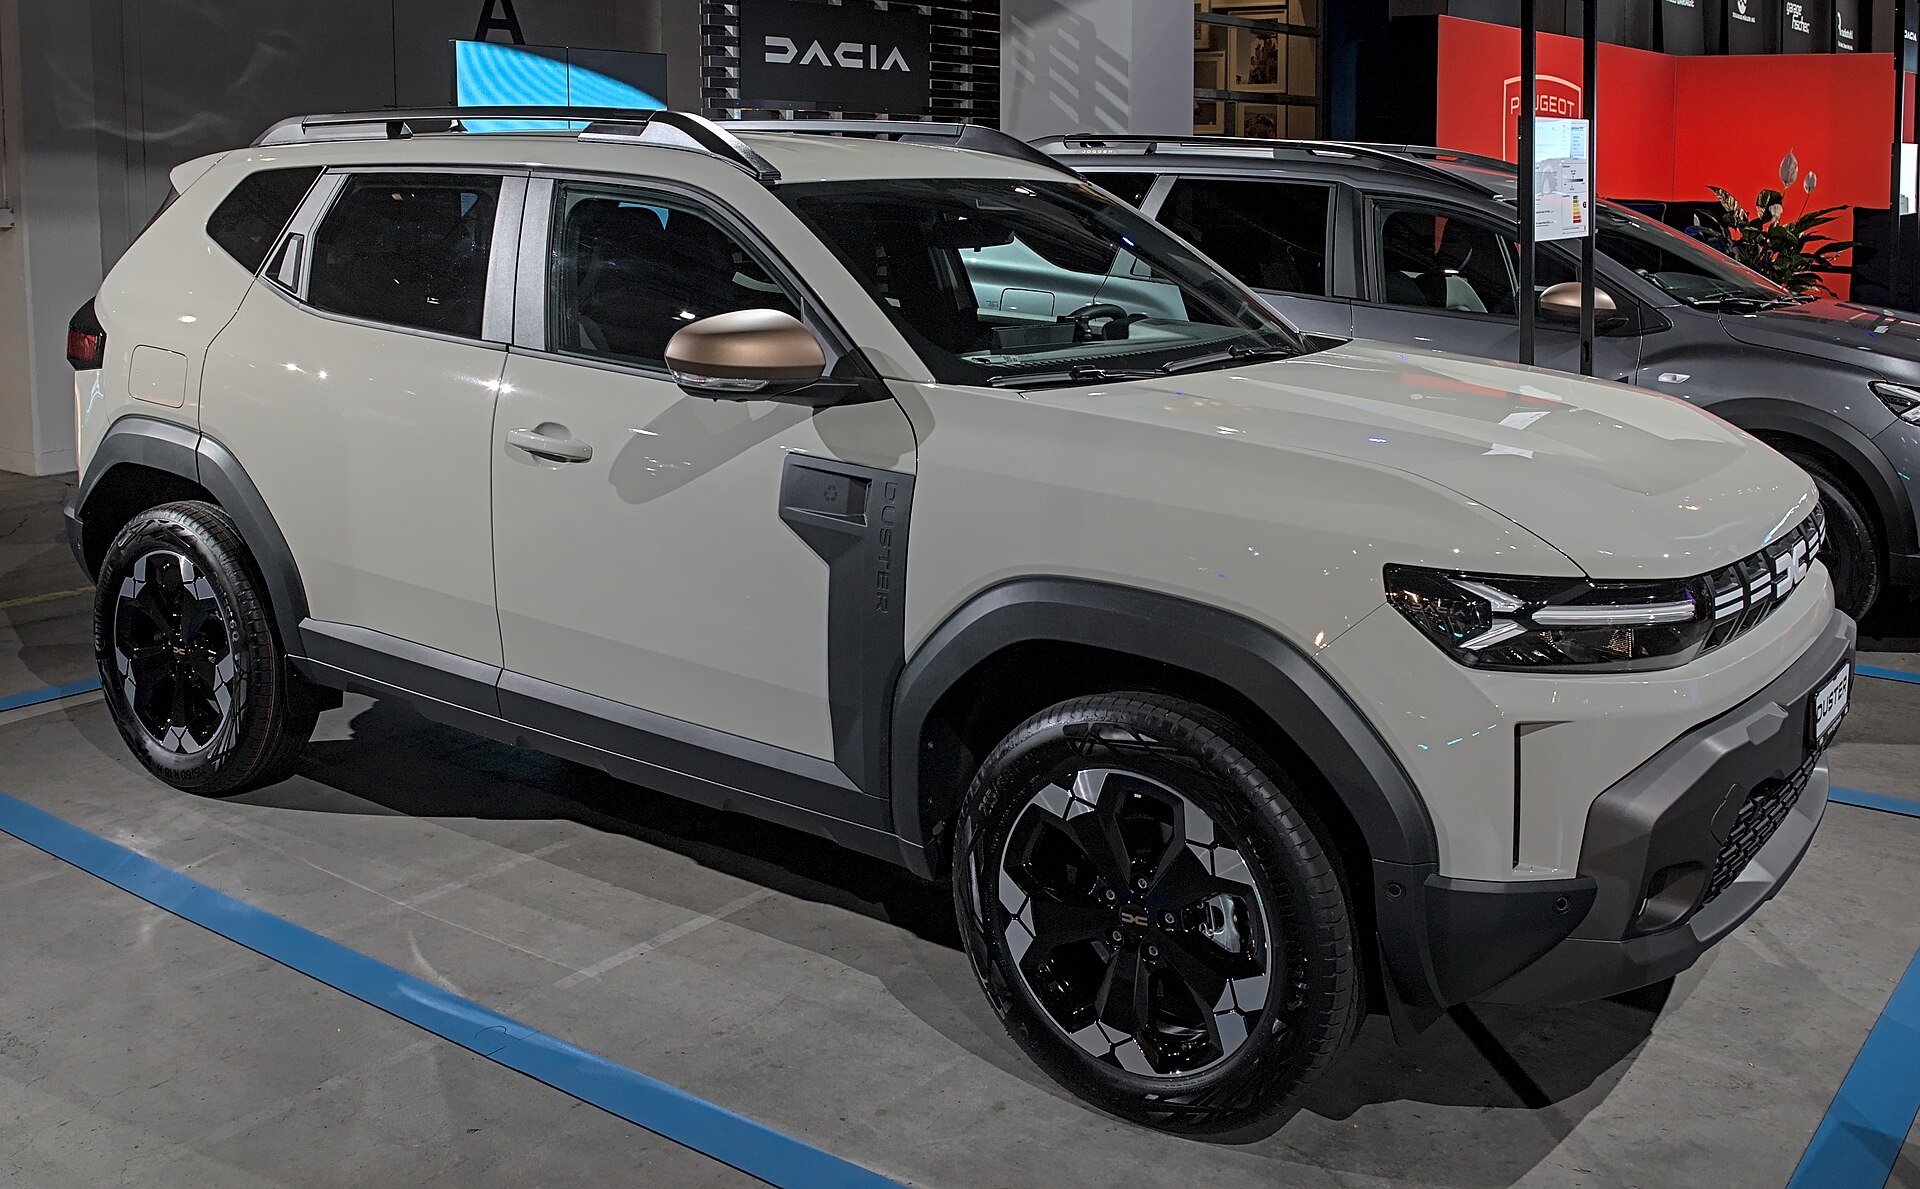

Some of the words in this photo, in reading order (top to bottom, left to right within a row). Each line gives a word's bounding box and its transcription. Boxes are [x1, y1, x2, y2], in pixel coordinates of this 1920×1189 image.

[474, 0, 526, 45] A
[765, 36, 911, 72] DACIA
[1511, 95, 1574, 117] PGEOT
[875, 481, 898, 614] DUSTER
[1817, 675, 1848, 725] DUSTER
